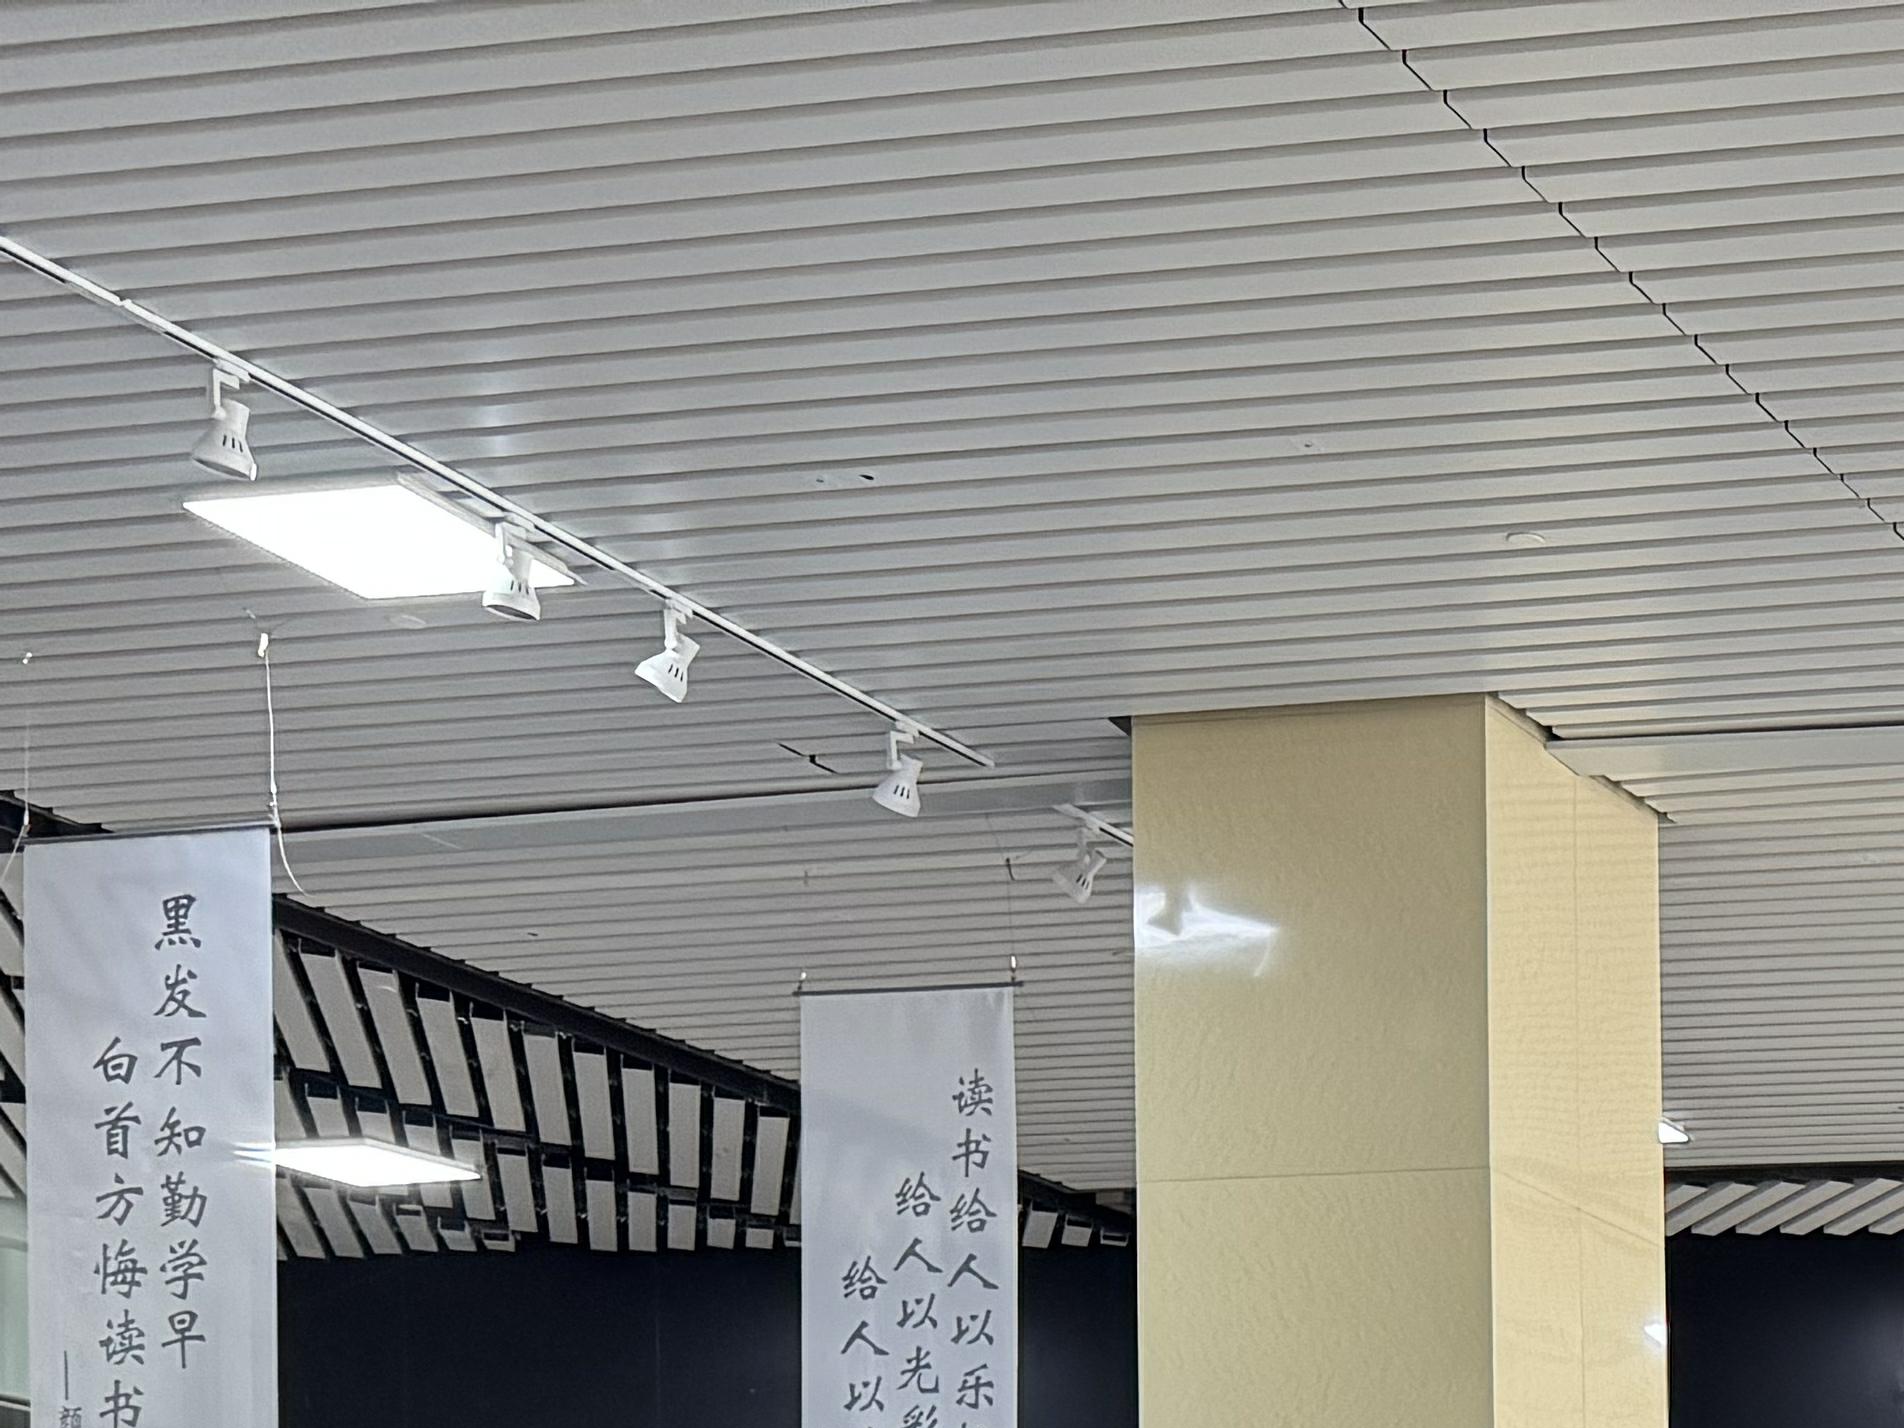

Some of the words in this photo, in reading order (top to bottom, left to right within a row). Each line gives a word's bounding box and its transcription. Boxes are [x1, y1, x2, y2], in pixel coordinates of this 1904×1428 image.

[152, 893, 208, 1369] 黑发不知勤学早
